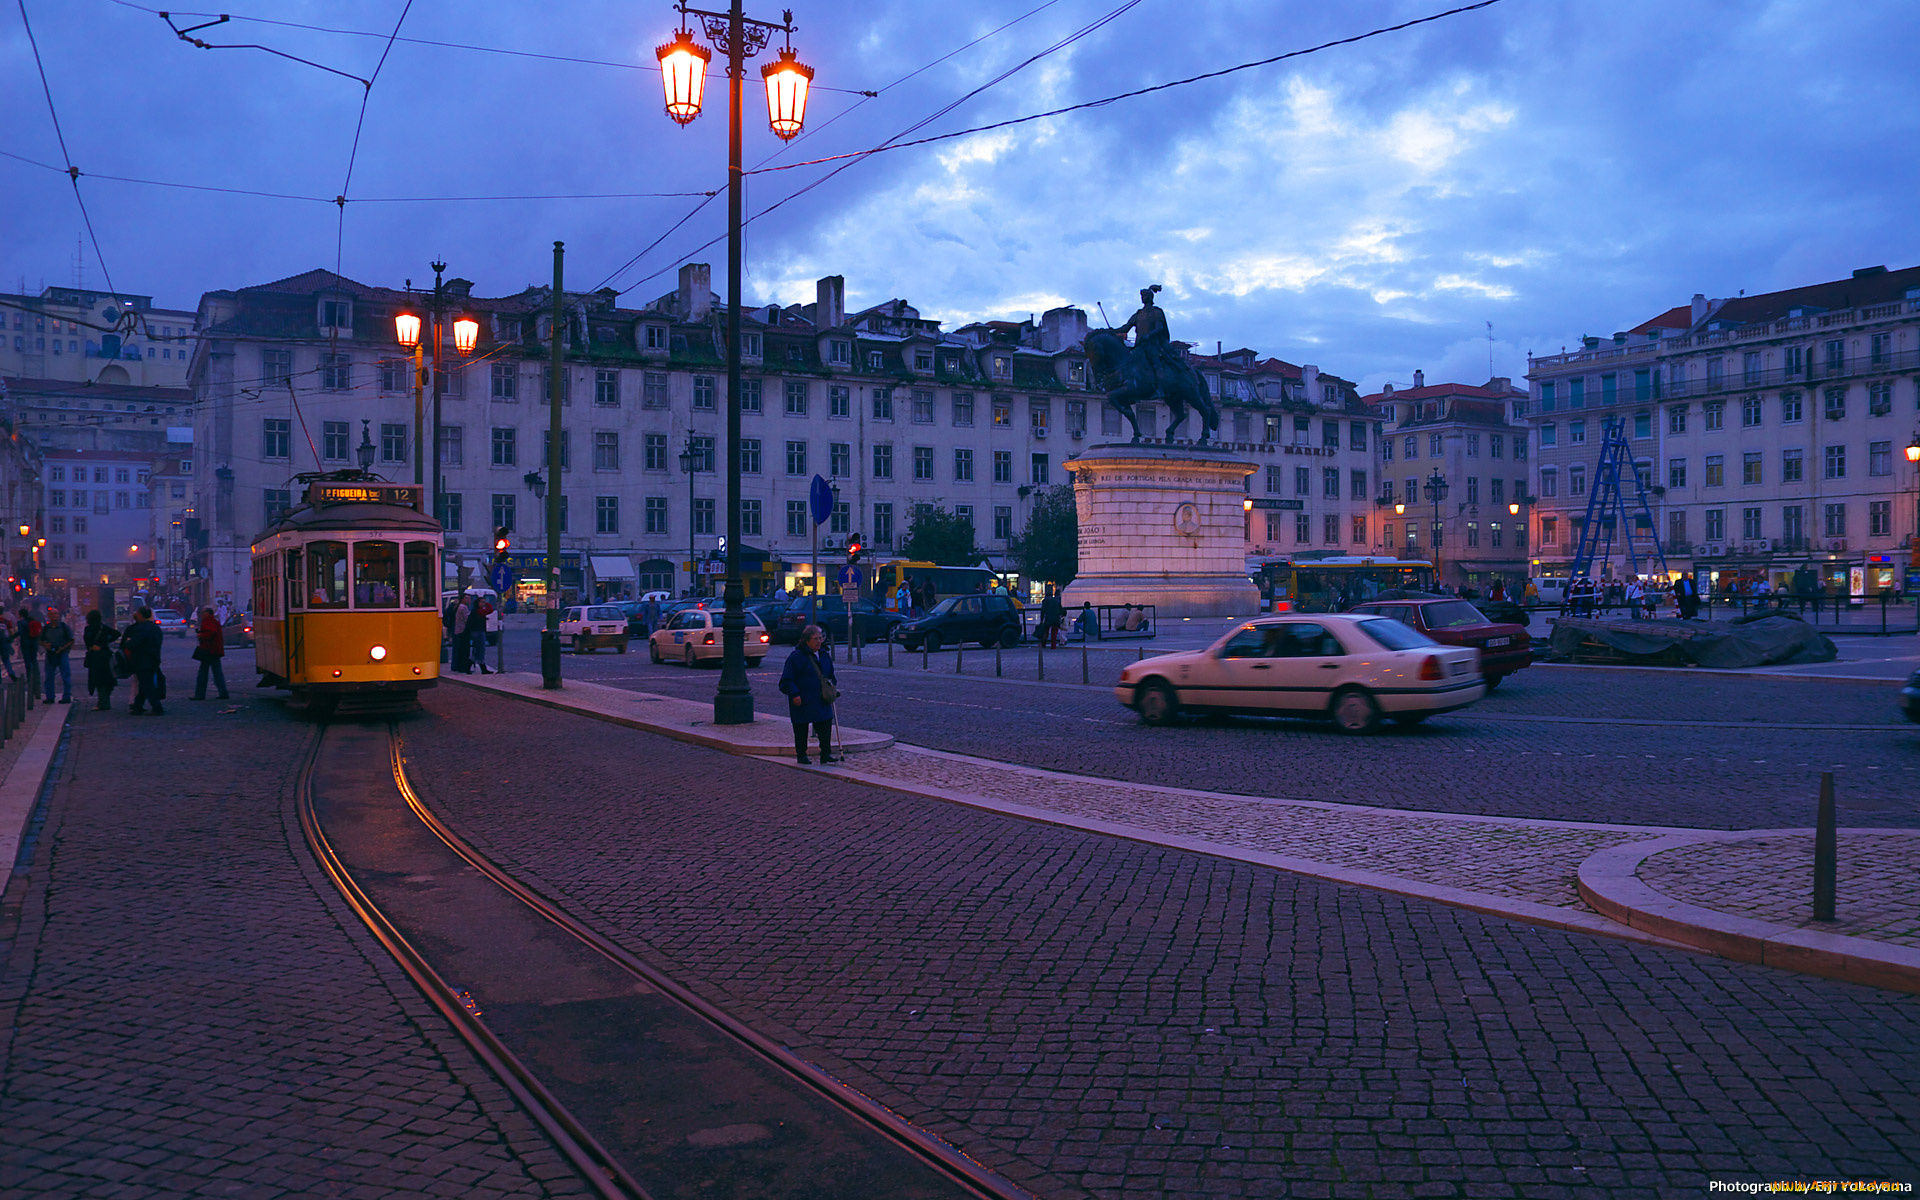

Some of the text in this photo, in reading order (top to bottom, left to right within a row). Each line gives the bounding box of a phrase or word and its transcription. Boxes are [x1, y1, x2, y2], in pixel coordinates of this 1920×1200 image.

[1285, 445, 1336, 457] MADRID
[394, 488, 409, 501] 12
[524, 557, 540, 568] DA
[542, 557, 580, 568] SRTE
